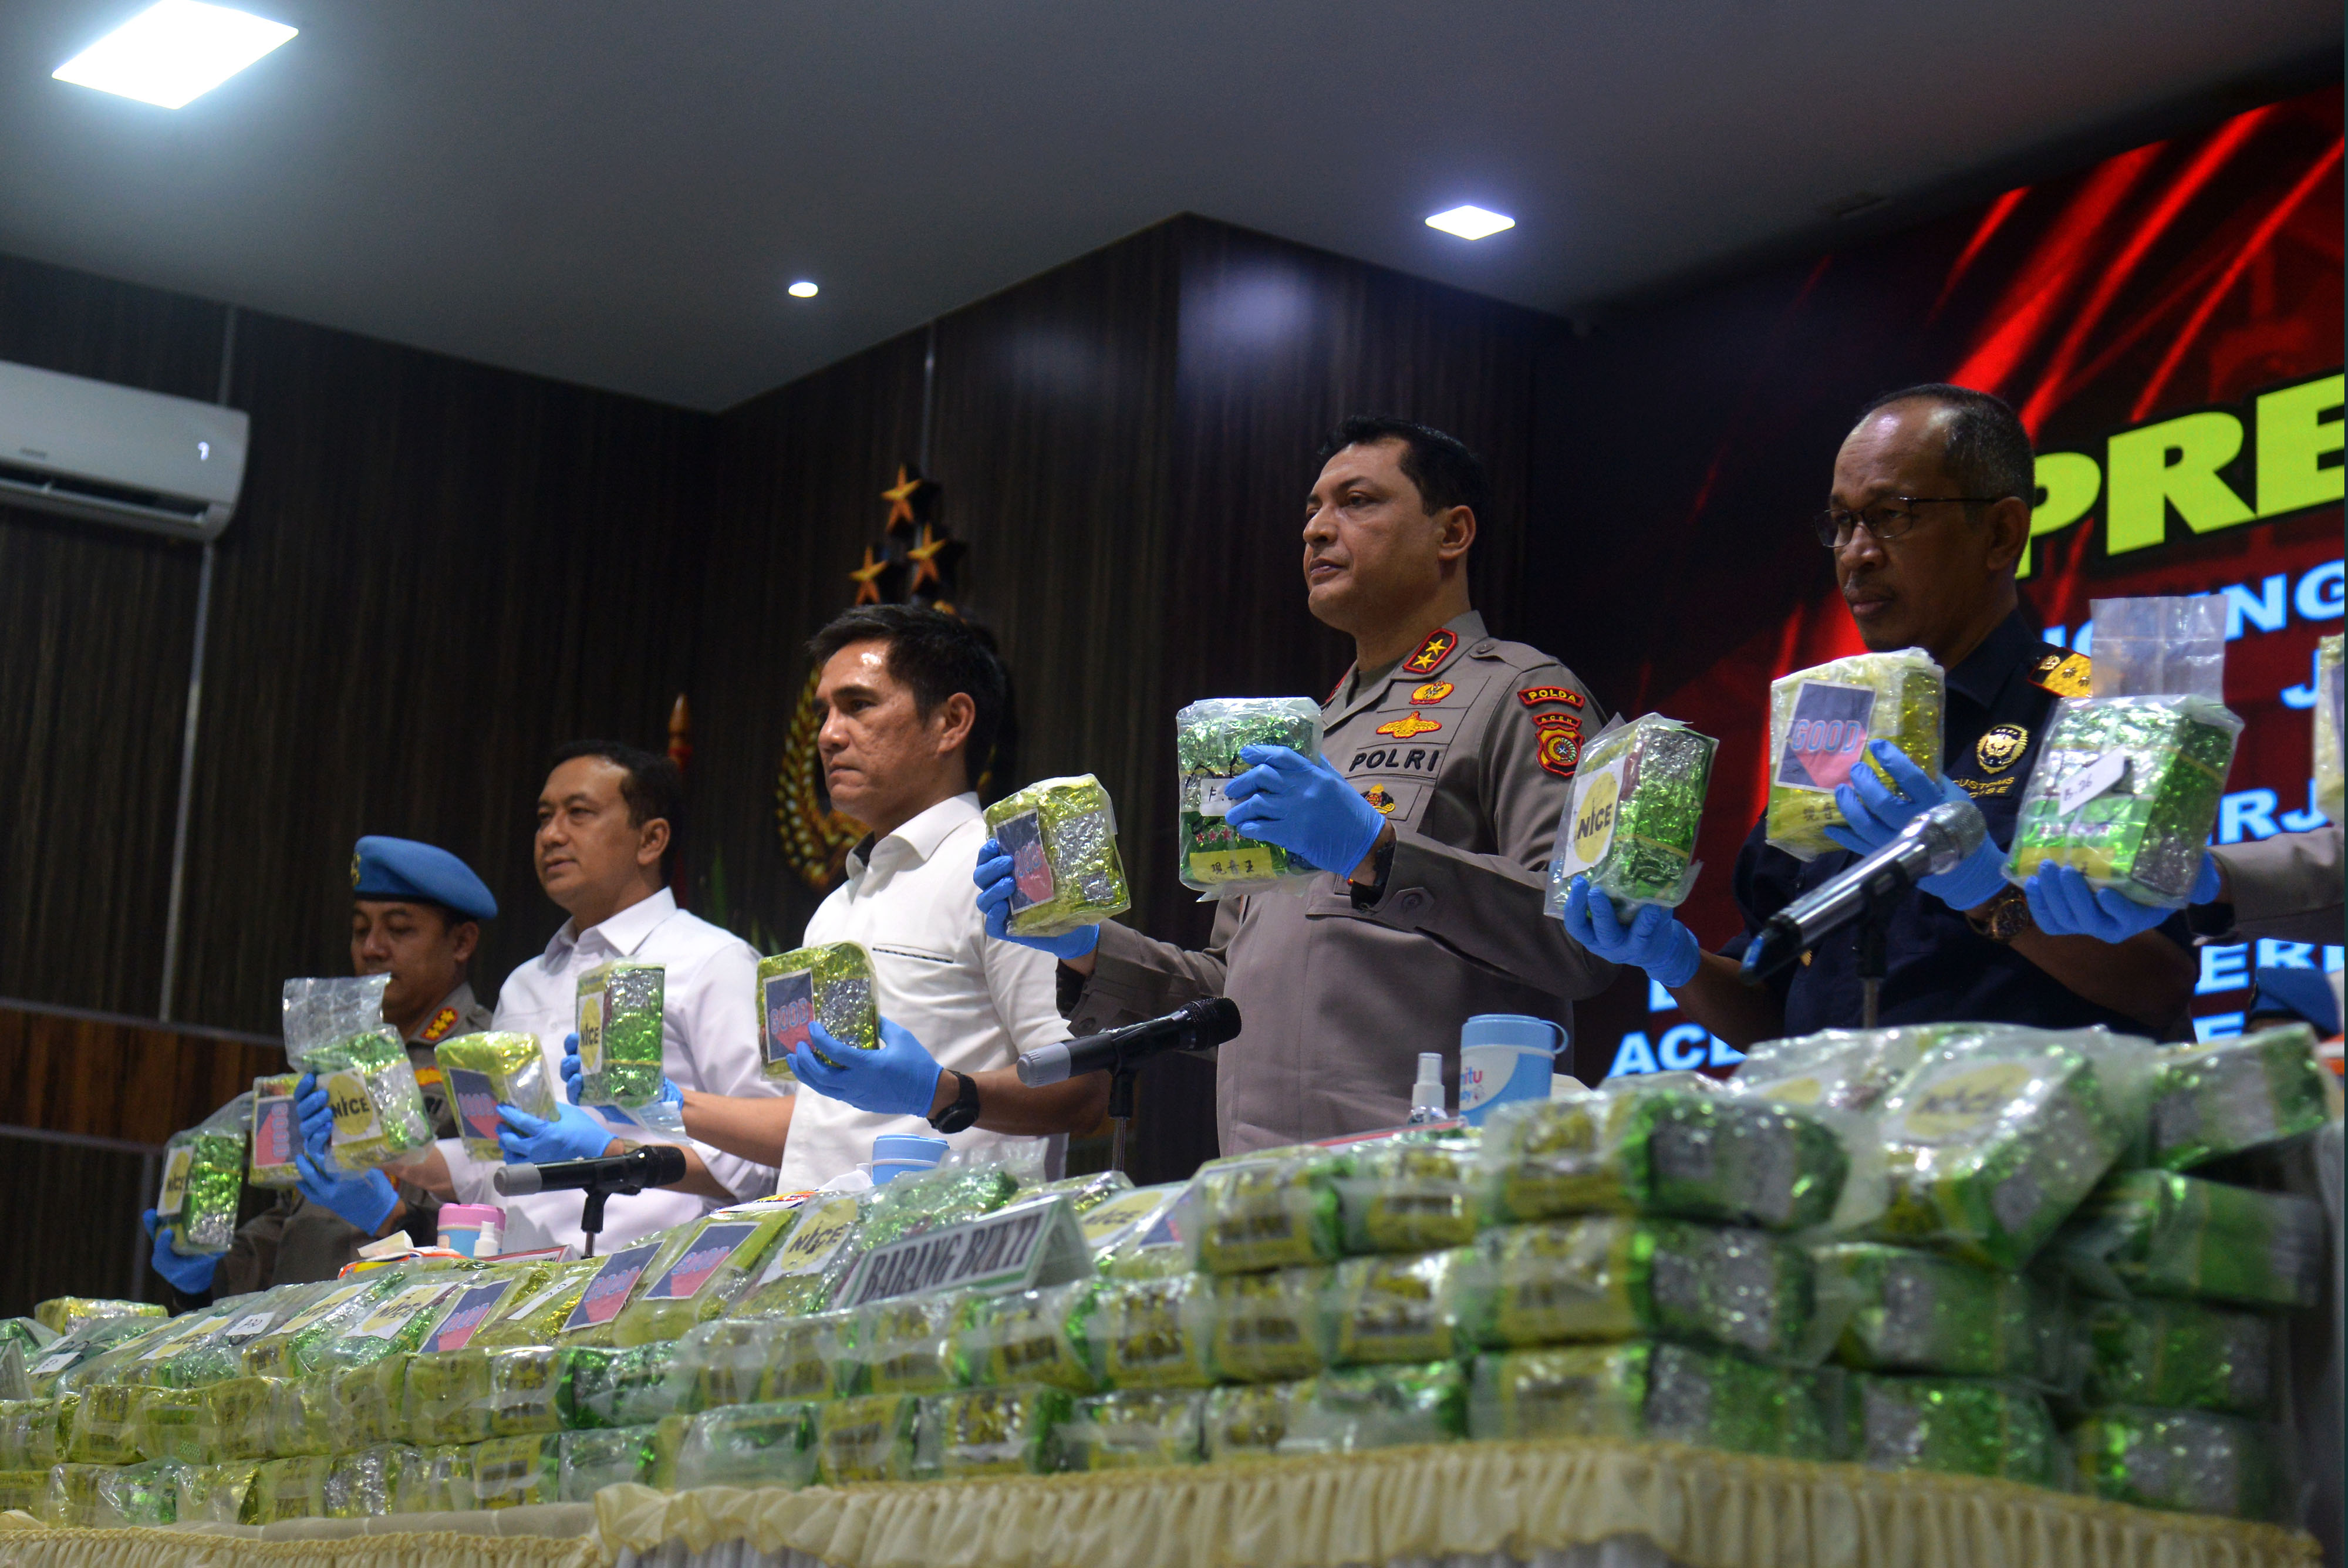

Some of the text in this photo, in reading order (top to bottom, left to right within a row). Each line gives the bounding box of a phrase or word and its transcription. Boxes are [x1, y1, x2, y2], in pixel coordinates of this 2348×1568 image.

[1528, 689, 1577, 703] POLDA
[1541, 715, 1573, 724] ACEH
[1792, 719, 1863, 754] GOOD
[1349, 748, 1439, 772] POLRI
[1577, 795, 1613, 840] NICE
[2207, 778, 2329, 845] RJ
[770, 997, 809, 1035] GOOD
[332, 1090, 370, 1118] NICE
